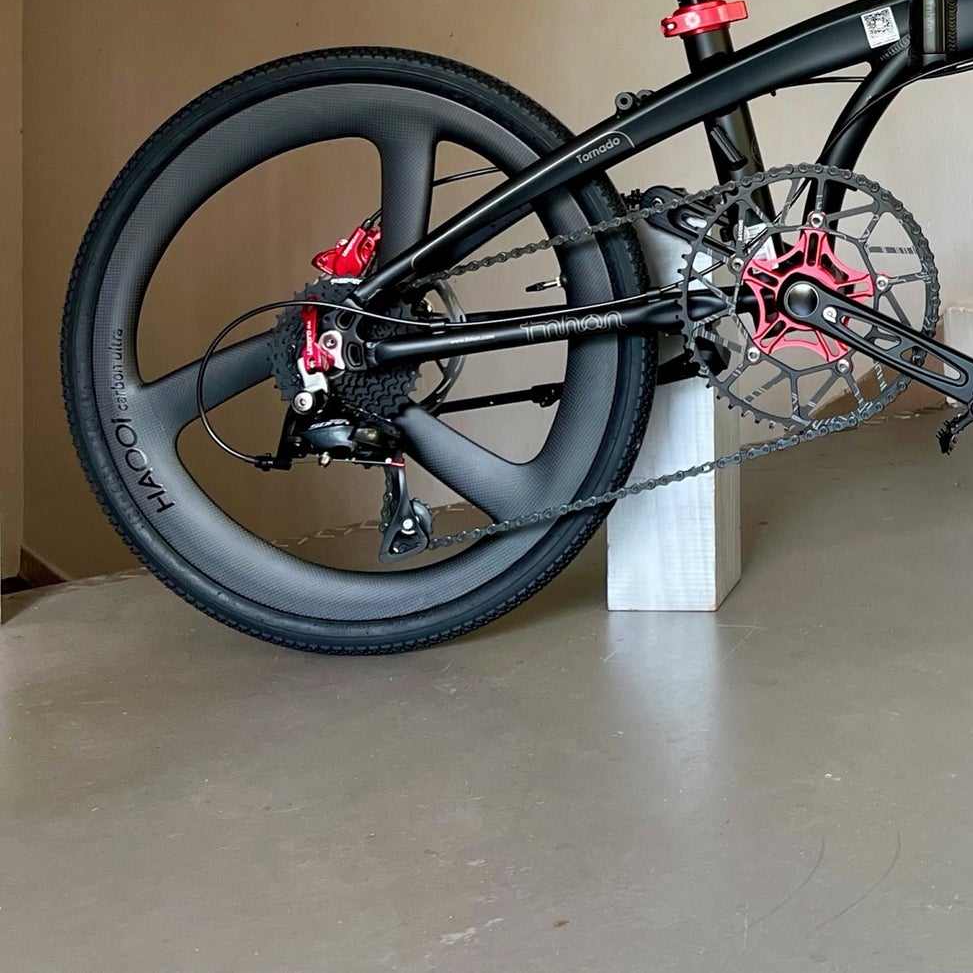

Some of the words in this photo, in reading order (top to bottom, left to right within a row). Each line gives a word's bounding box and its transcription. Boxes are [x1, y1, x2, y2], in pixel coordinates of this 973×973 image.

[575, 137, 621, 164] Tornado
[108, 328, 124, 361] ultra
[110, 365, 129, 412] carbon
